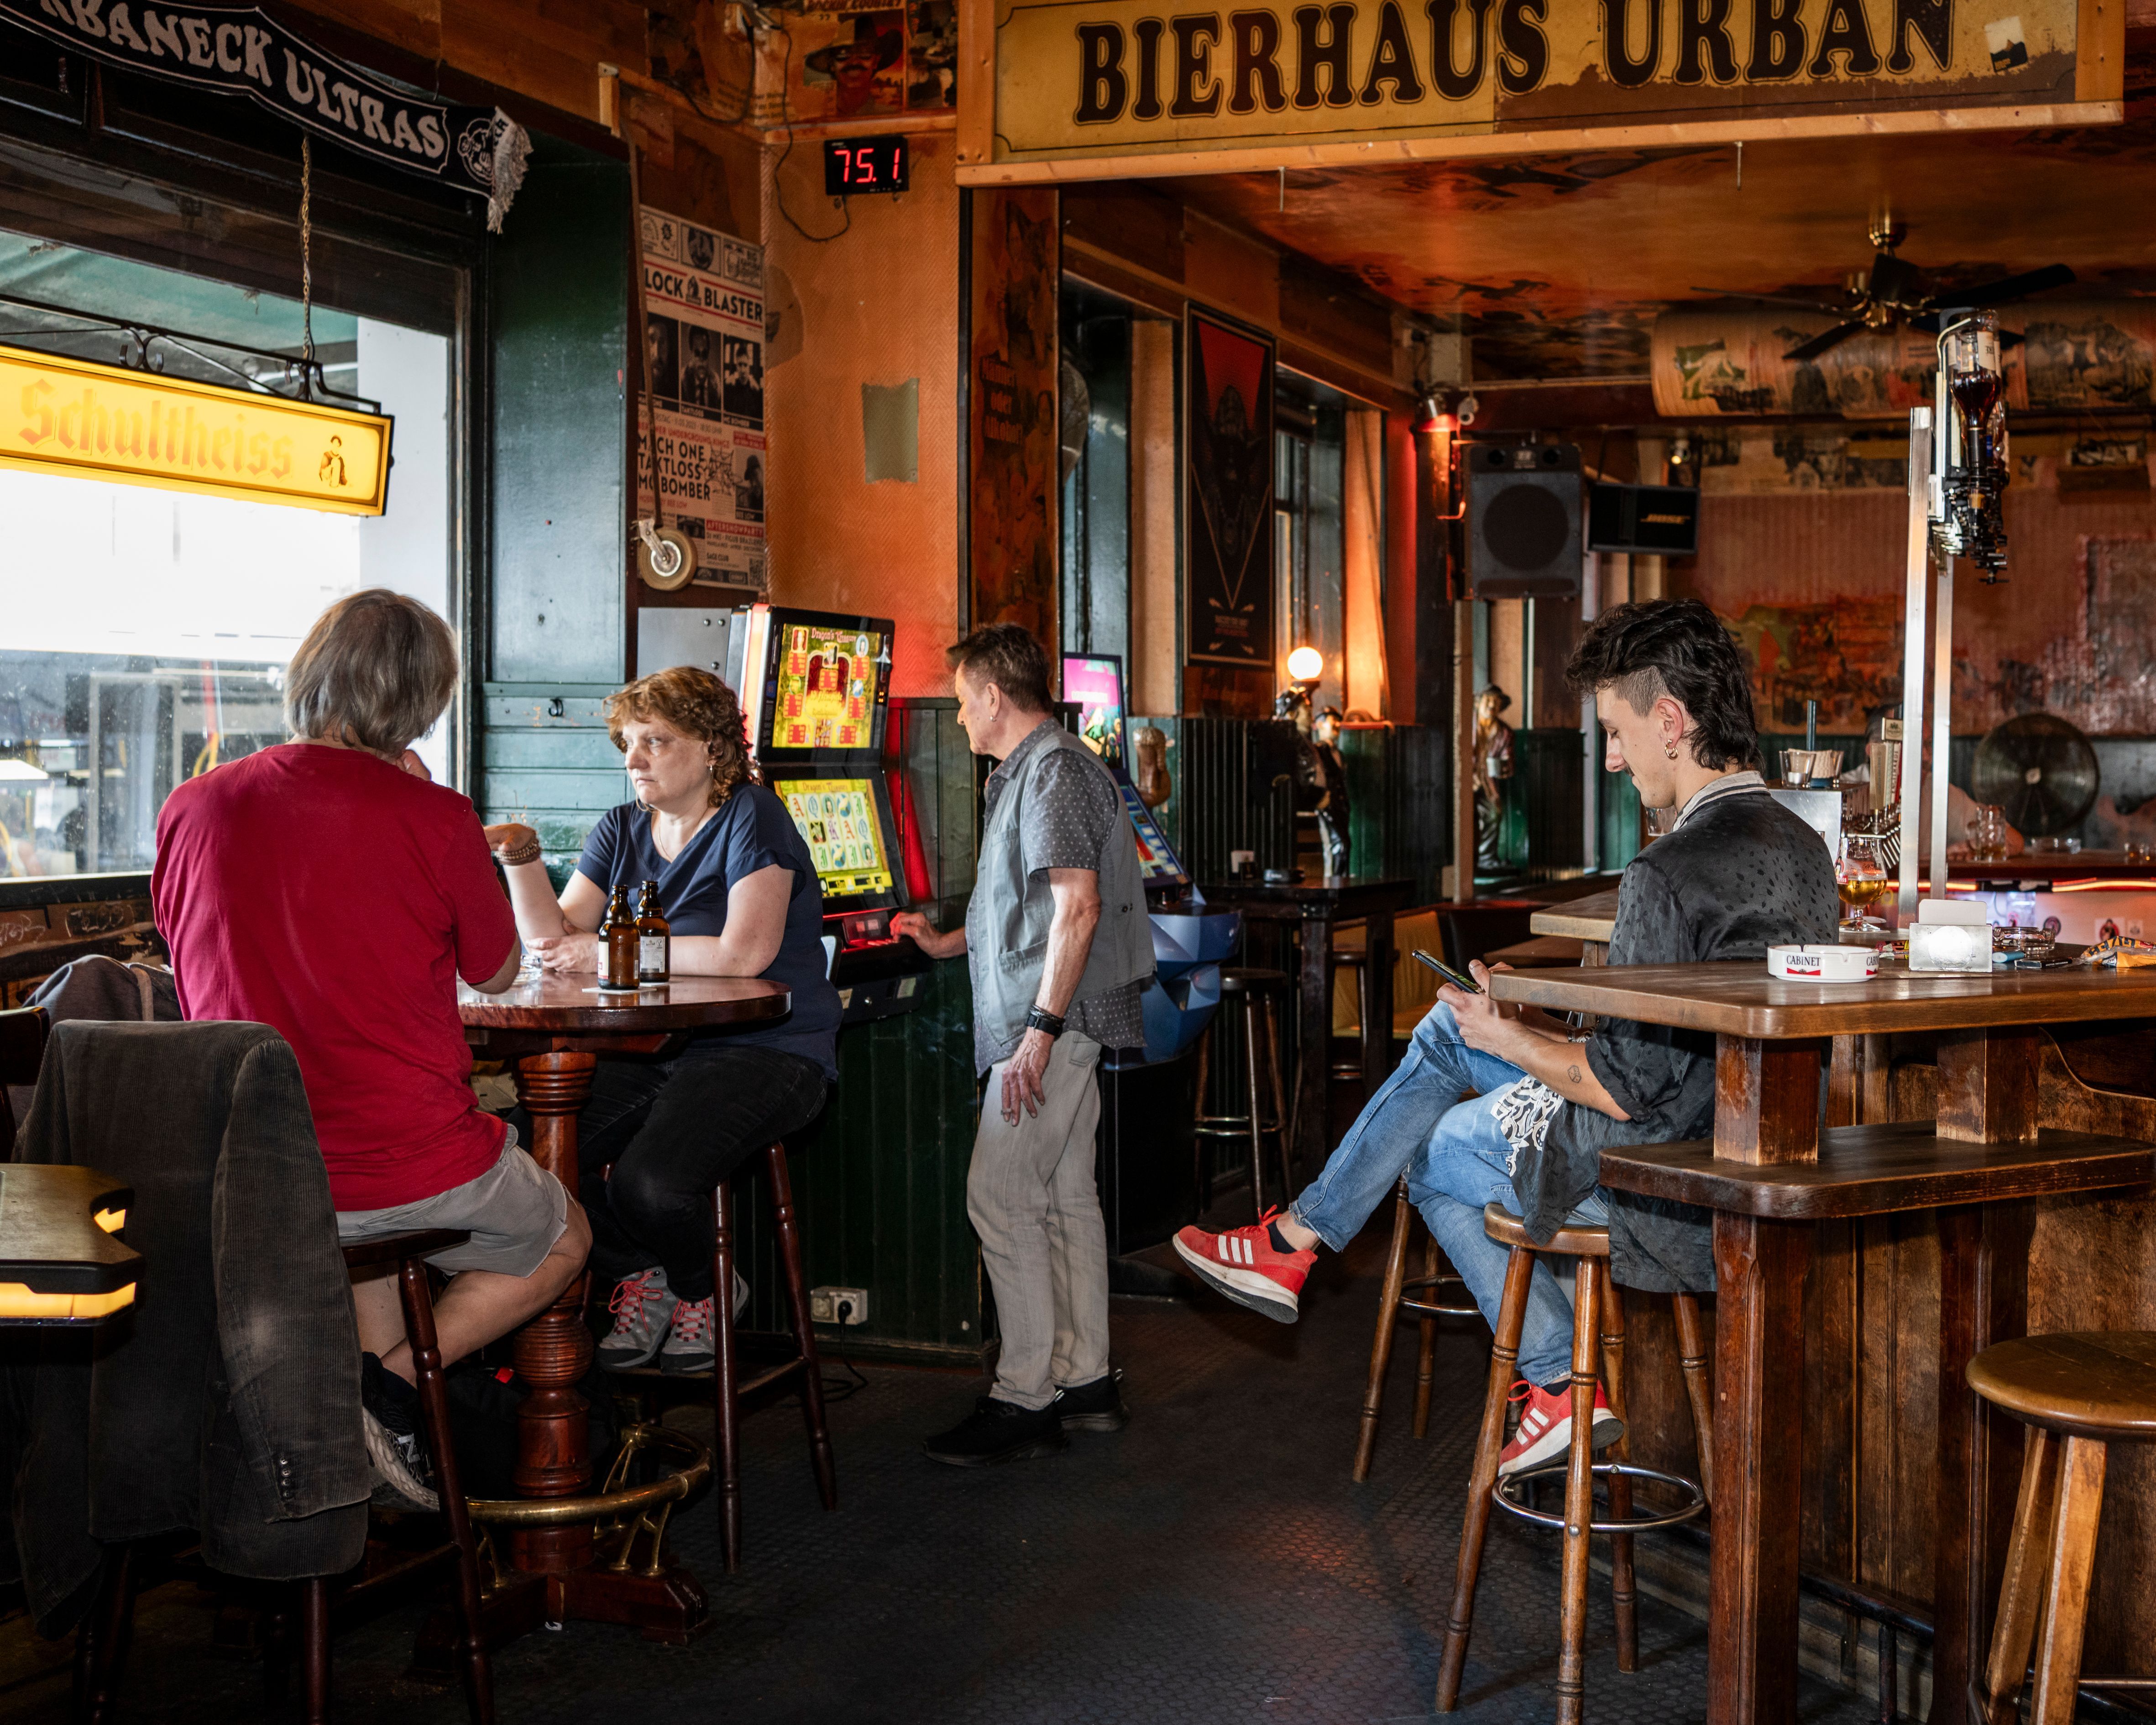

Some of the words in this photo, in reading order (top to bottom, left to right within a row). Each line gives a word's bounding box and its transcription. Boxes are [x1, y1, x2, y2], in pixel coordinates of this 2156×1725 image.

[1073, 0, 1550, 125] BIERHAUS
[1601, 0, 1954, 87] URBAN
[283, 47, 446, 158] ULTRAS
[704, 286, 763, 322] BLASTER
[18, 378, 294, 481] Schultheiss
[638, 434, 674, 456] MCH
[679, 441, 705, 462] ONE
[661, 477, 711, 501] BOMBER
[1786, 955, 1821, 966] CABINET
